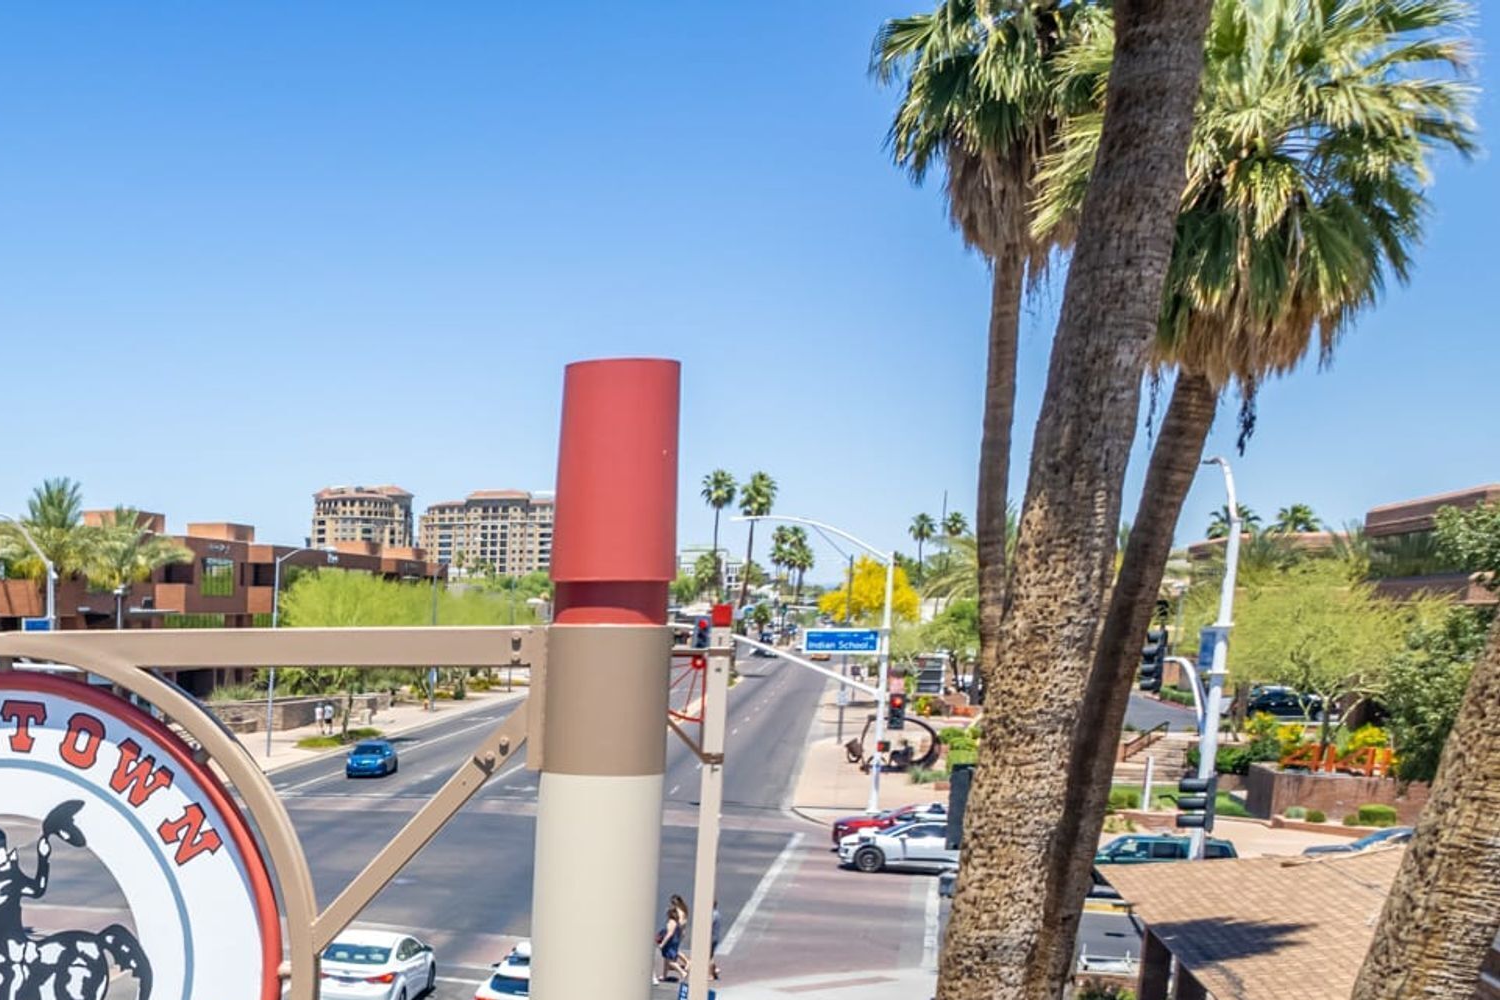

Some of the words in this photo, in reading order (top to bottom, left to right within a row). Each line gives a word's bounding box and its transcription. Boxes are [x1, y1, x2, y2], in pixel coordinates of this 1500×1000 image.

[808, 641, 836, 650] Indian
[838, 640, 869, 650] School
[0, 699, 224, 867] TOWN
